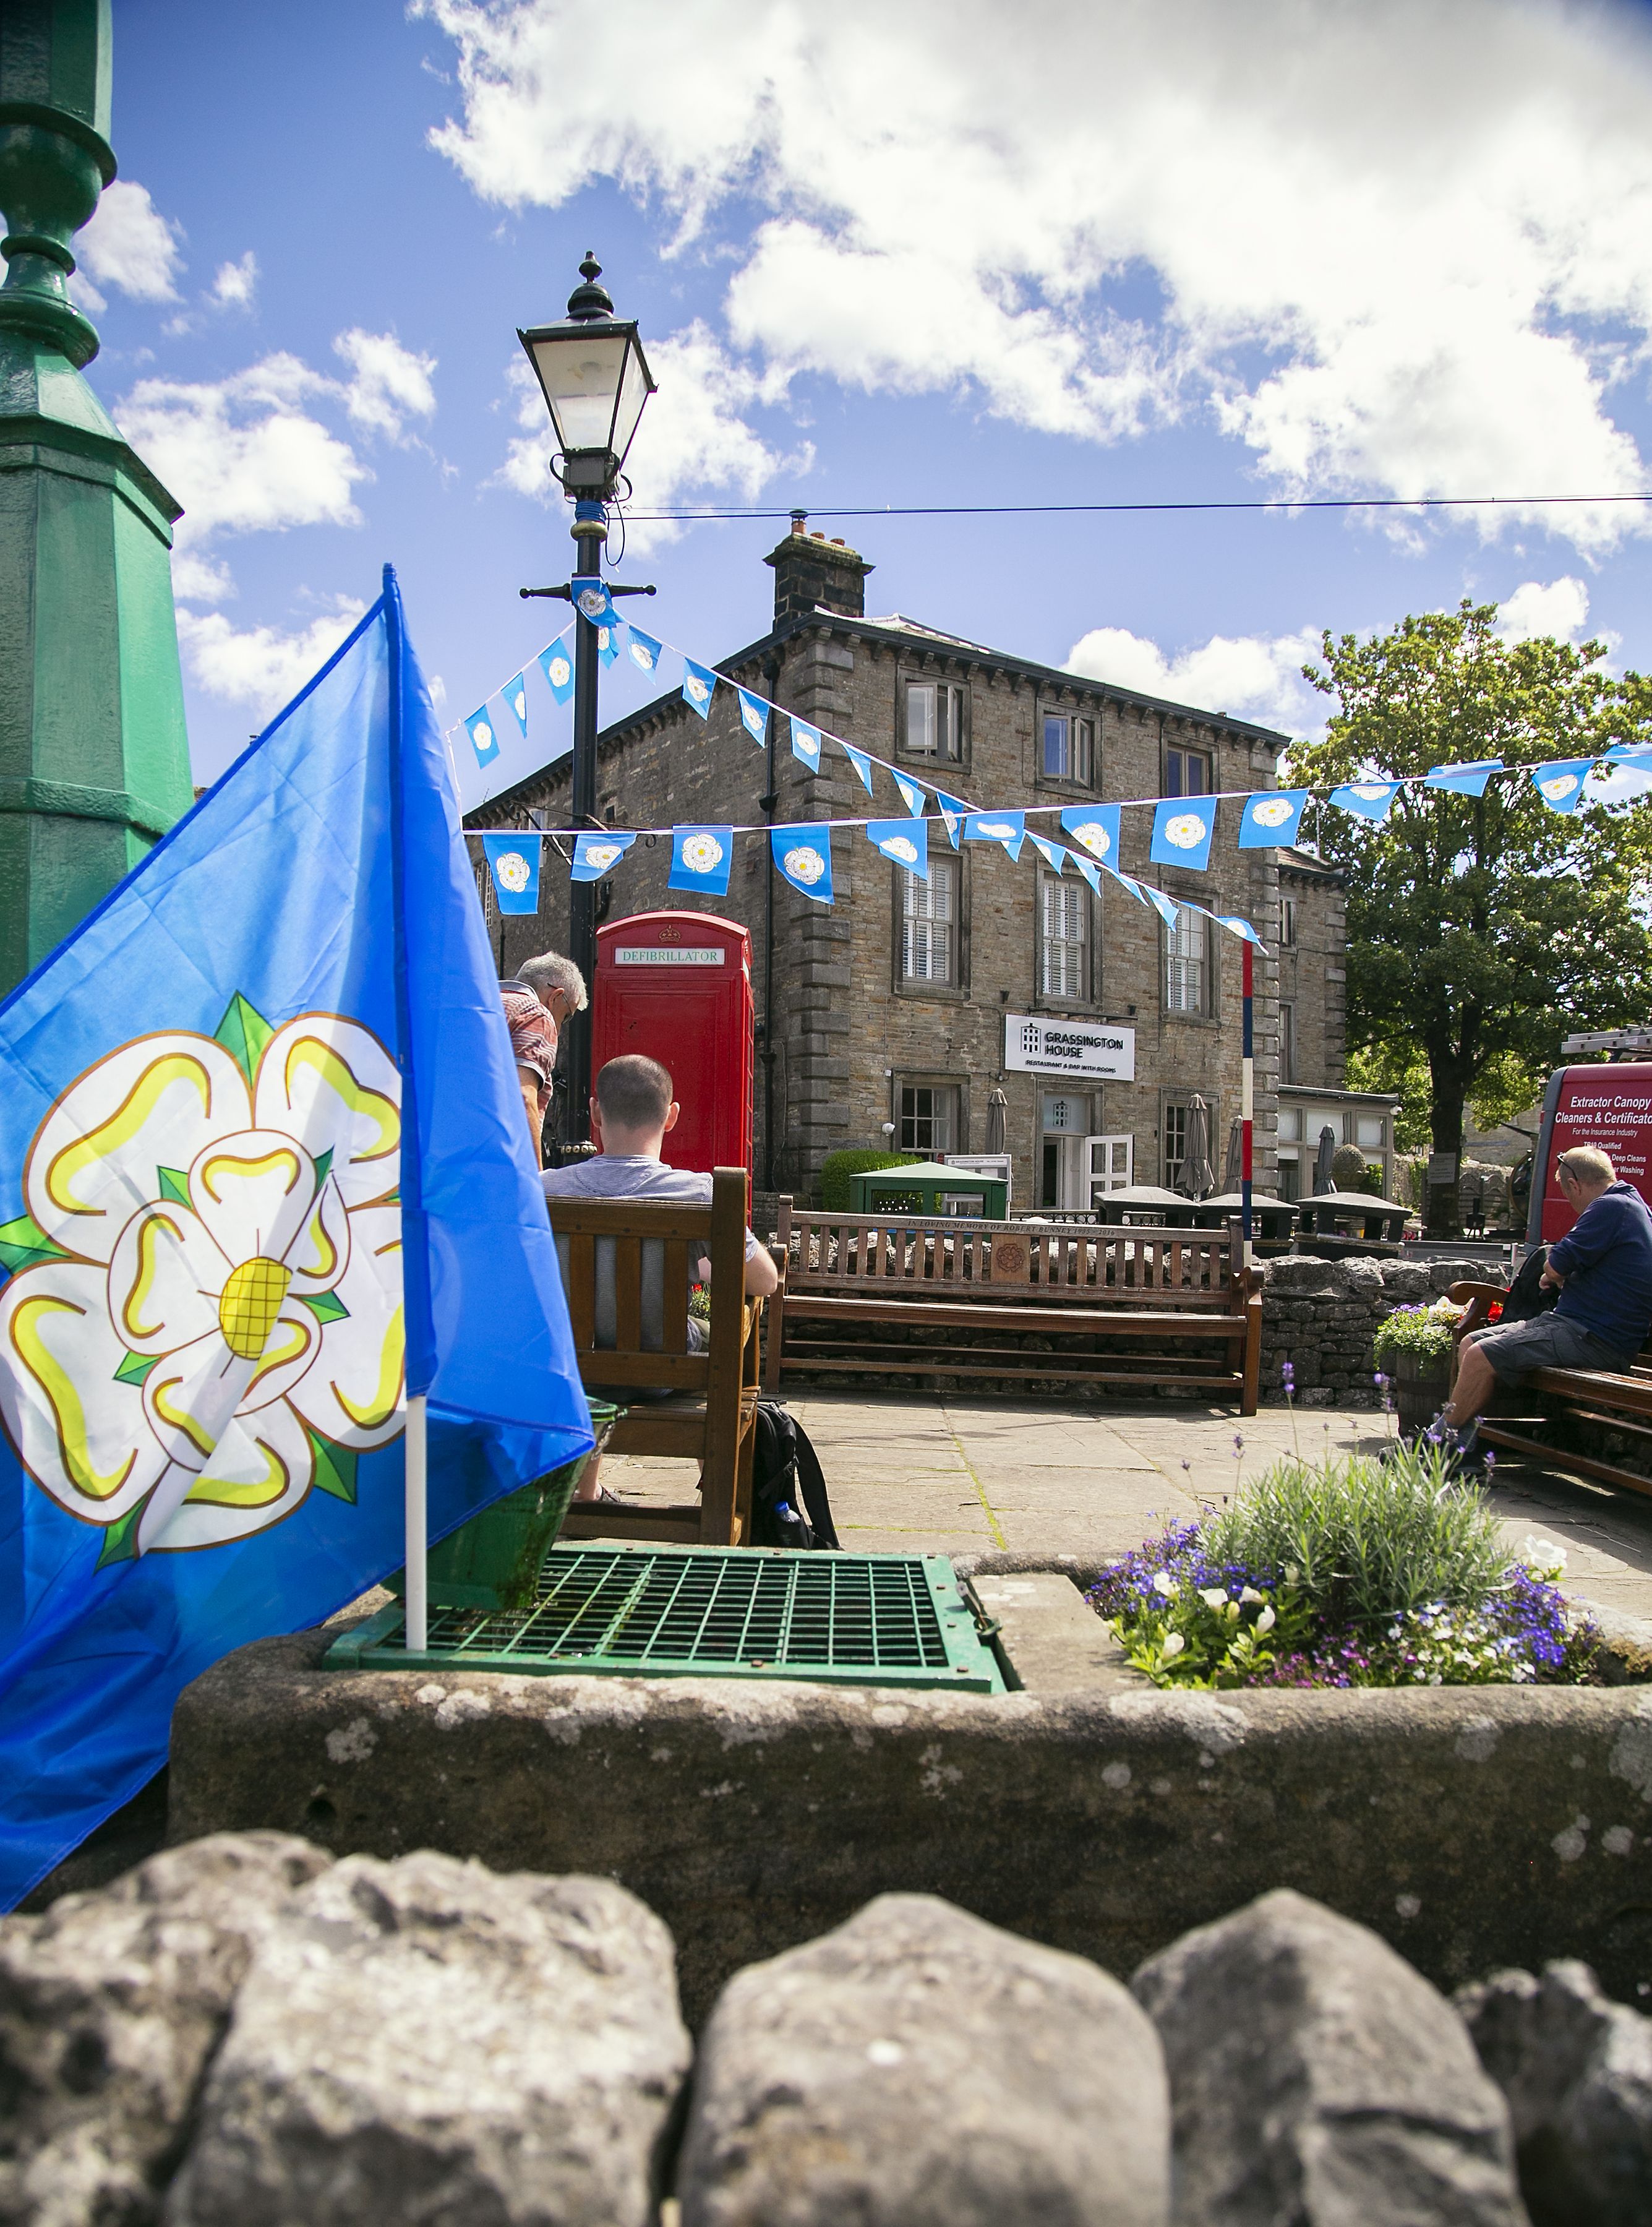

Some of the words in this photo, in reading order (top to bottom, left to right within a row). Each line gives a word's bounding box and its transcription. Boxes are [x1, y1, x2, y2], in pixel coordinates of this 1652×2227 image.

[623, 951, 717, 961] DEFIBRILLATOR
[1045, 1032, 1123, 1050] GRASSINGTON
[1045, 1045, 1083, 1058] HOUSE
[1025, 1060, 1062, 1068] RESTAURANT
[1570, 1096, 1612, 1108] Extractor
[1614, 1096, 1652, 1110] Canopy
[1555, 1112, 1593, 1124] Cleaners
[1594, 1112, 1602, 1124] &
[1590, 1128, 1616, 1136] Insurance
[1616, 1128, 1638, 1138] Industry
[1598, 1142, 1622, 1150] Qualified
[1612, 1154, 1625, 1163] Deep
[1627, 1155, 1646, 1163] Cleans
[1620, 1167, 1645, 1176] Washing
